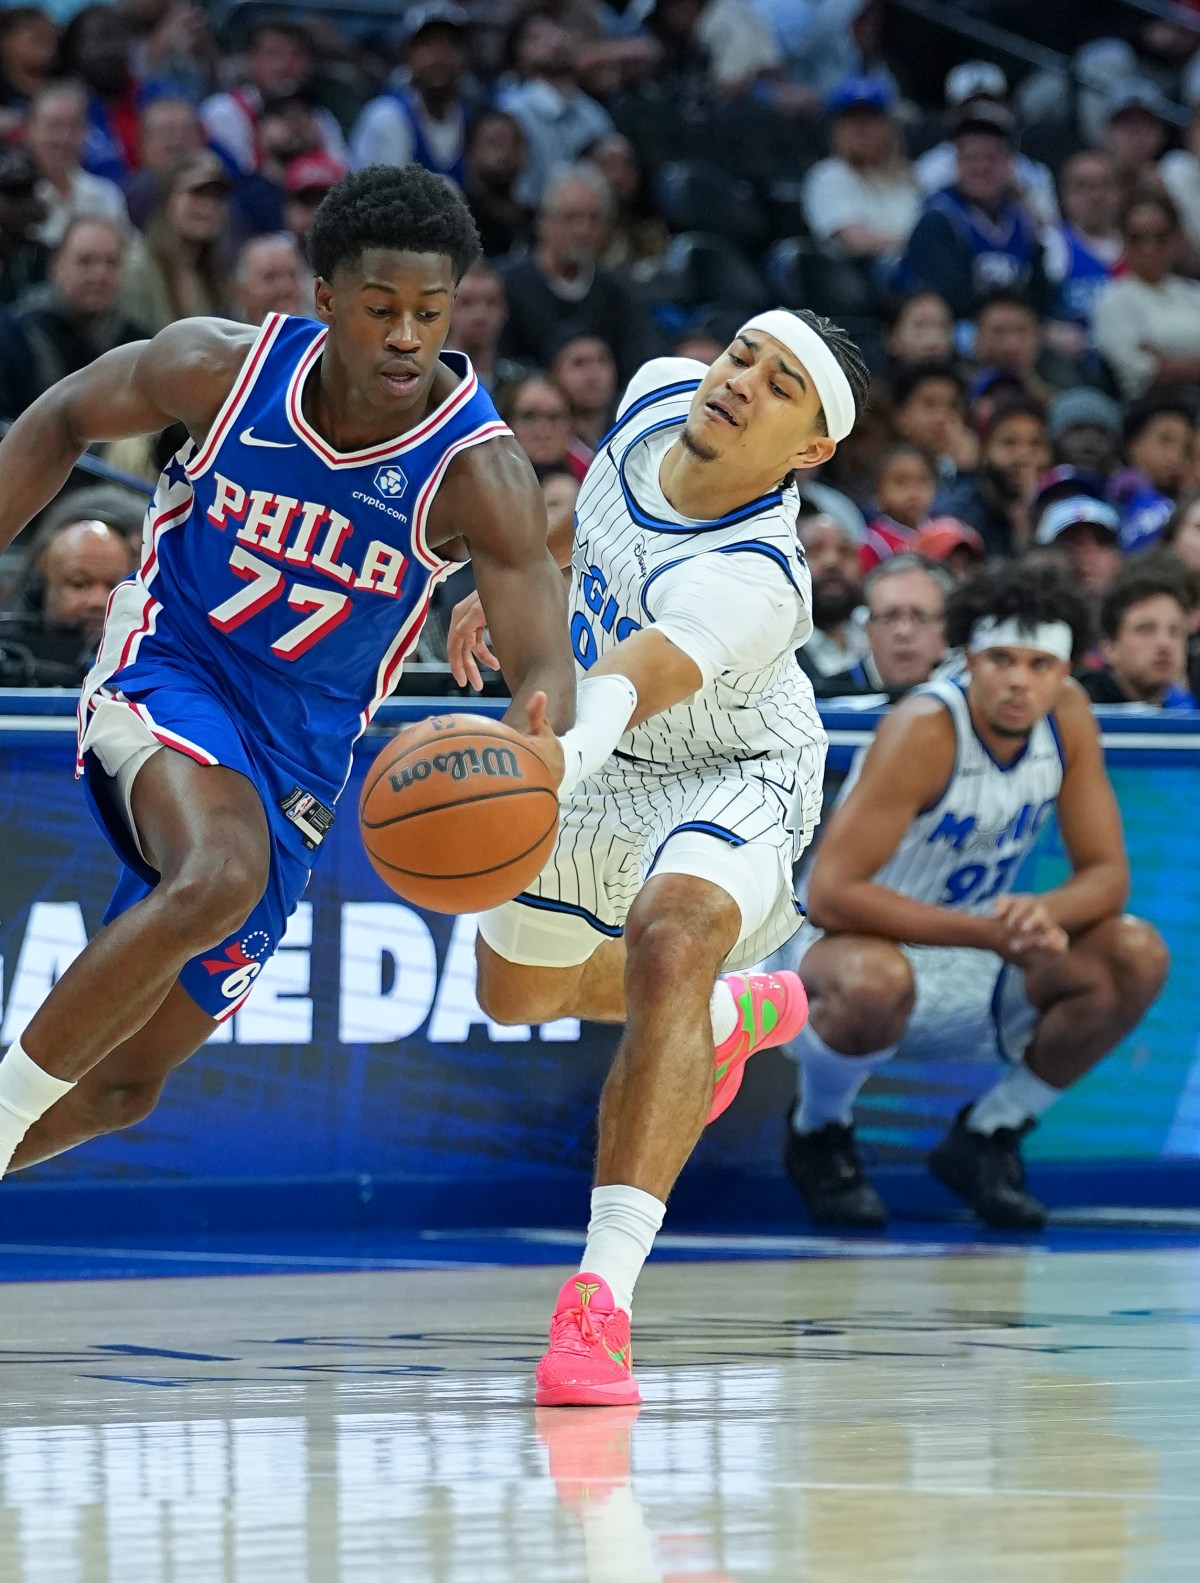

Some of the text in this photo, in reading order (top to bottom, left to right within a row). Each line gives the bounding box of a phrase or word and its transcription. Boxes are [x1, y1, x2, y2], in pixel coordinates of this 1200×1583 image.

[207, 471, 409, 599] PHILA
[352, 491, 408, 524] crypto.com
[208, 545, 353, 662] 77
[387, 747, 523, 793] Wilson
[338, 901, 581, 1044] DA
